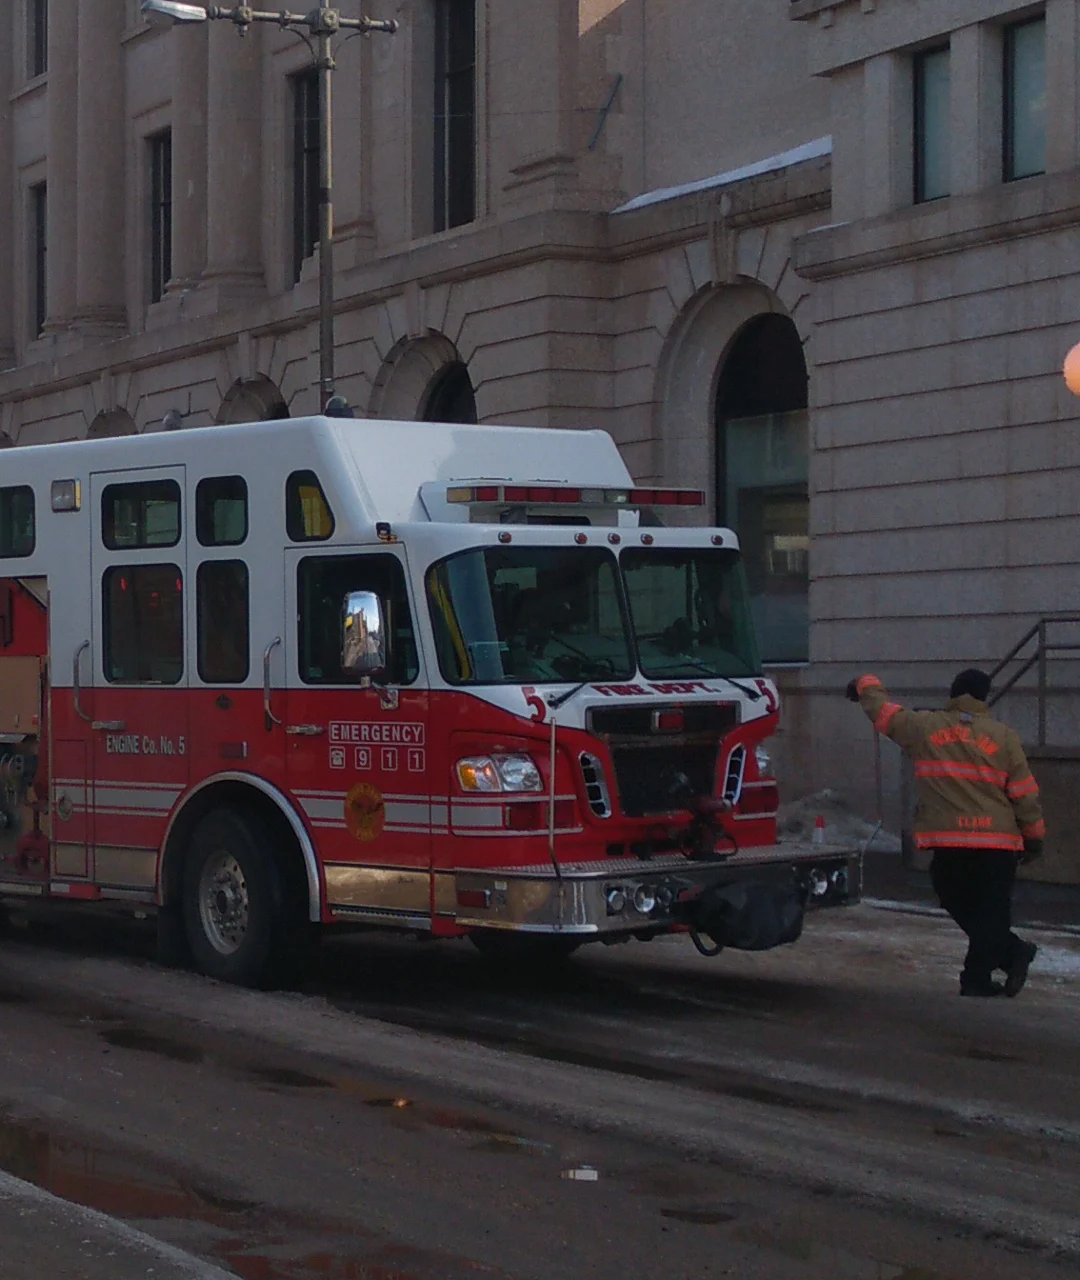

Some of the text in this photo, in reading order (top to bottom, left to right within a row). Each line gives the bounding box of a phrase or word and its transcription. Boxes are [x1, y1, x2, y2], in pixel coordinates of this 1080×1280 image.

[590, 684, 654, 697] FIRE
[754, 679, 777, 714] 5
[521, 686, 546, 723] 5
[331, 724, 422, 742] EMERGENCY
[106, 735, 140, 754] ENGINE
[178, 736, 185, 755] 5
